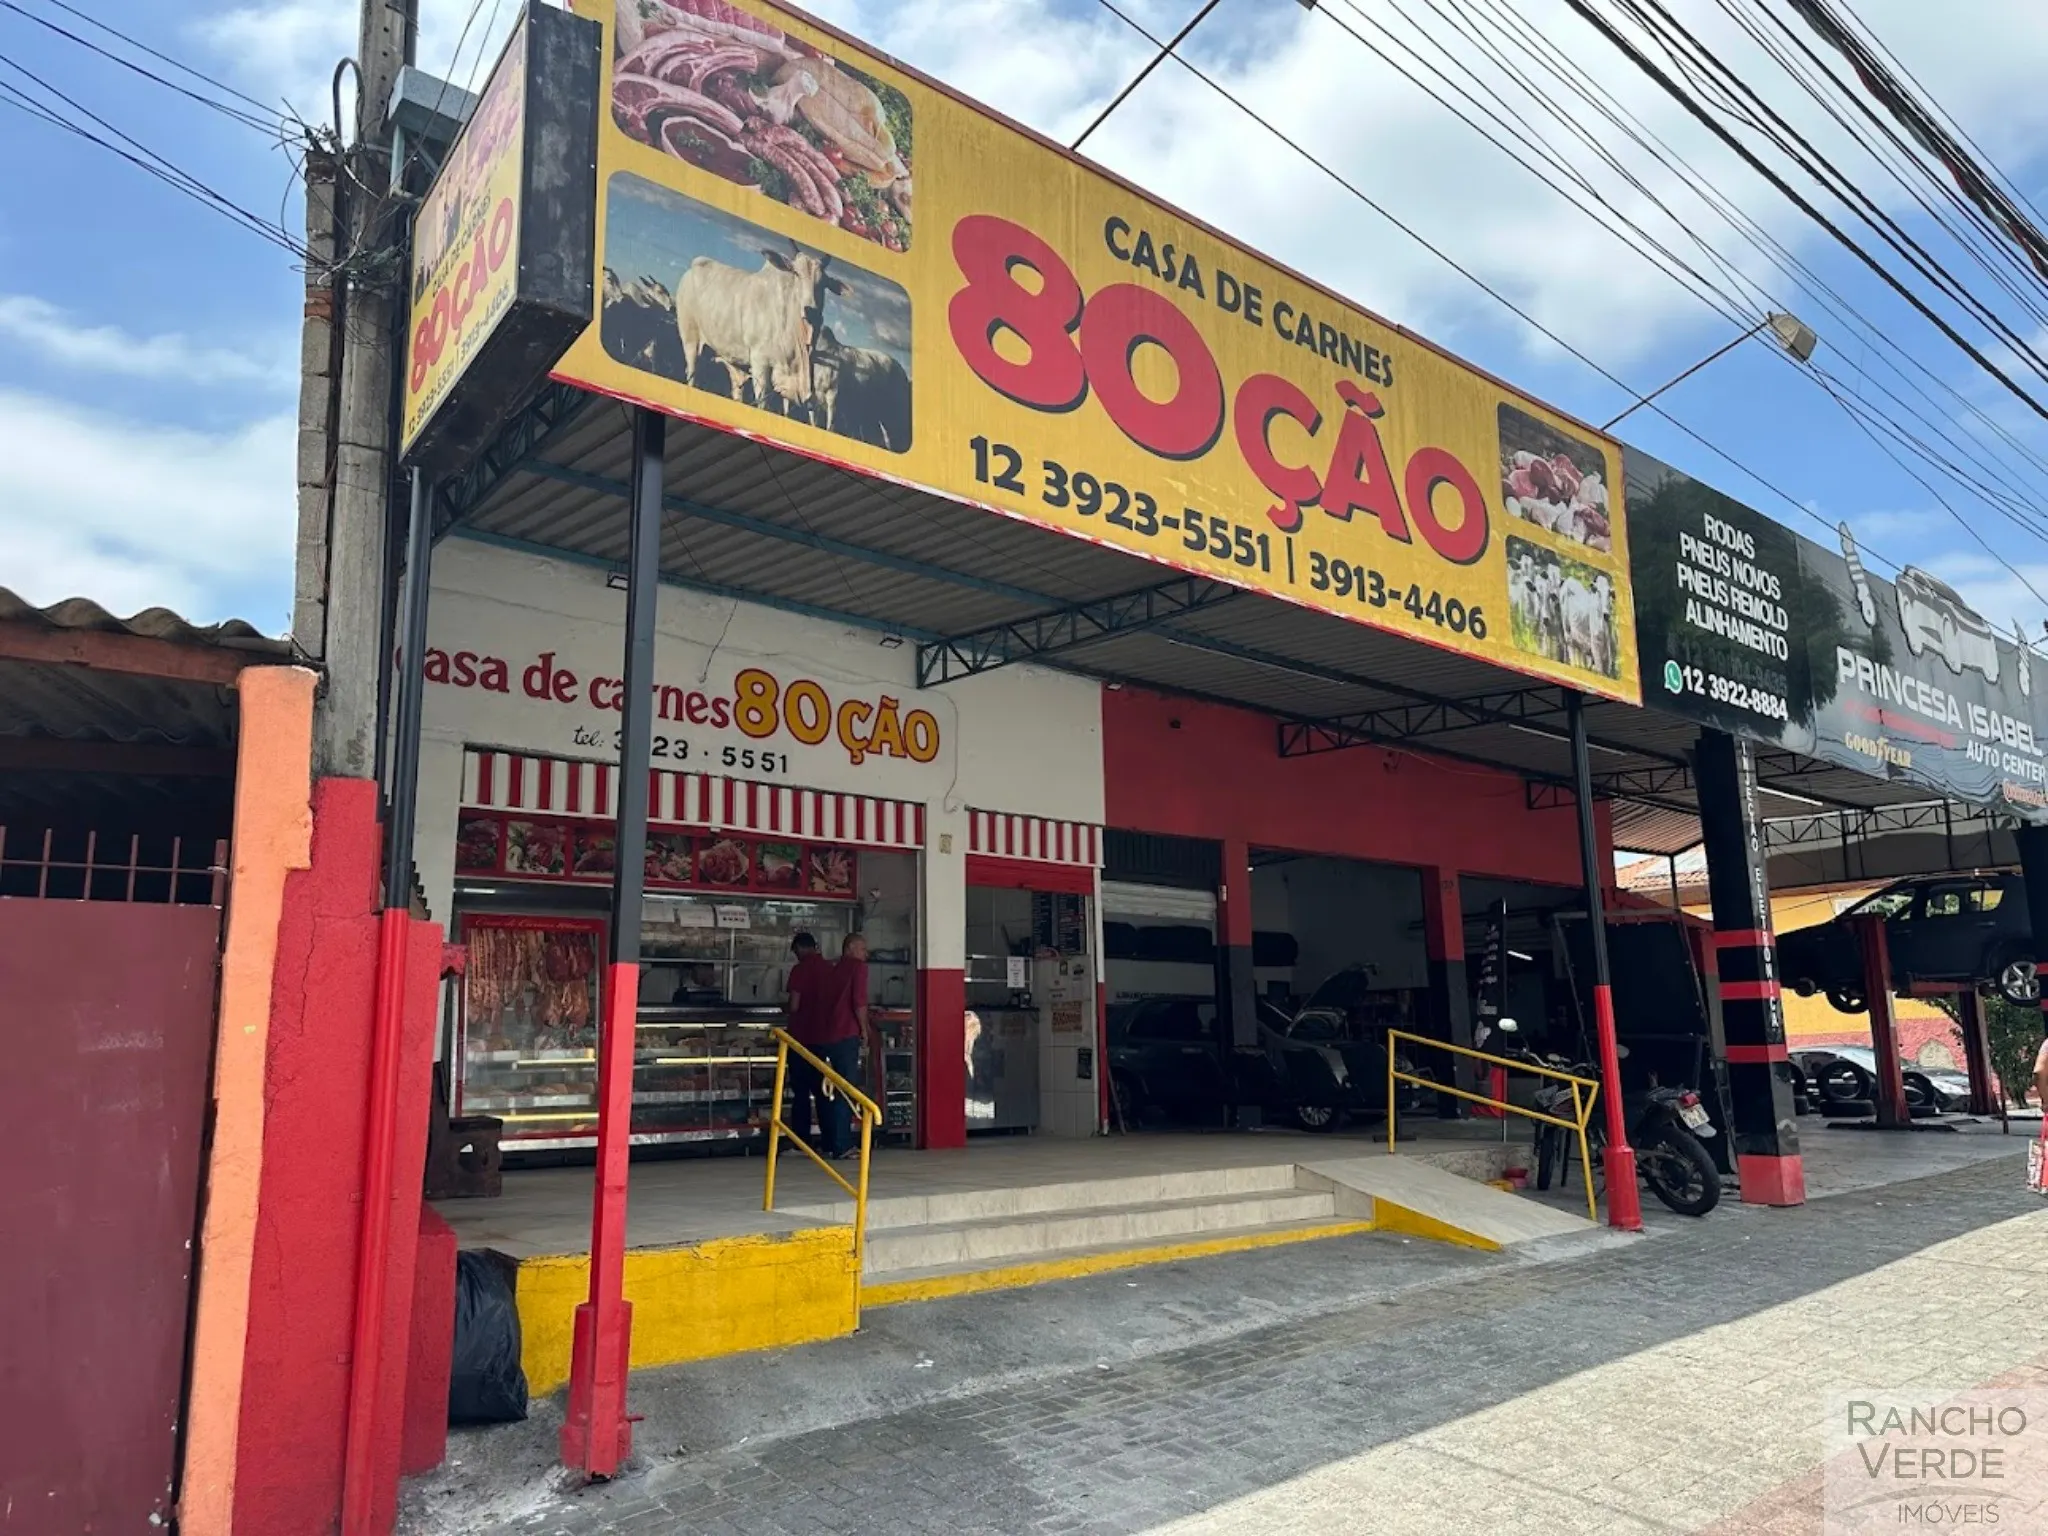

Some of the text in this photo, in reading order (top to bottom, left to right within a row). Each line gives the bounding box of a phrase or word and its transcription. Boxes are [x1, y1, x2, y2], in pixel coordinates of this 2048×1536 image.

[1104, 215, 1394, 388] CASA DE CARNES
[970, 434, 1026, 495] 12
[1042, 461, 1271, 573] 3923-5551
[1310, 550, 1488, 640] 3913-4406
[1680, 531, 1782, 601] PNEUS NOVOS
[1704, 512, 1756, 560] RODAS
[1676, 561, 1789, 632] PNEUS REMOLD
[1686, 598, 1789, 661] ALINHAMENTO
[395, 645, 510, 693] asa
[523, 652, 578, 704] de
[1683, 665, 1789, 721] 12 3922-8884
[1836, 645, 2044, 757] PRINCESA ISABEL
[613, 730, 689, 760] 323
[721, 746, 788, 774] 5551
[1844, 732, 1913, 768] GOODYEAR
[1965, 739, 2047, 783] AUTO CENTER
